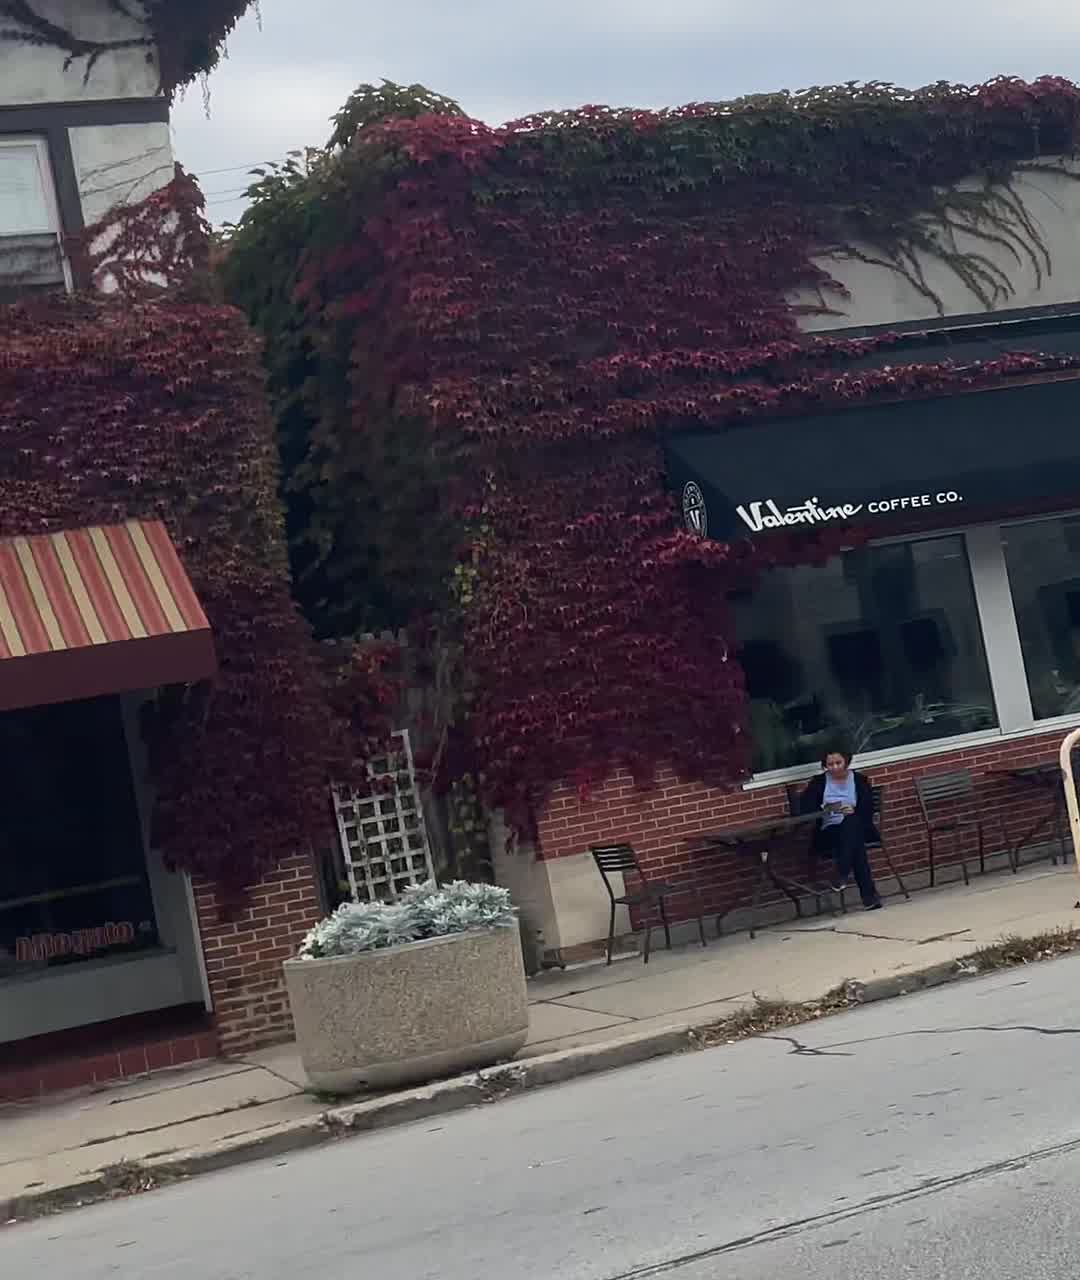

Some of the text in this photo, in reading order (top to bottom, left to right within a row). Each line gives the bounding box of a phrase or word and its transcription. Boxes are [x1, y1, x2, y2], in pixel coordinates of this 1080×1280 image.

[736, 491, 963, 532] Valentine COFFEE CO.
